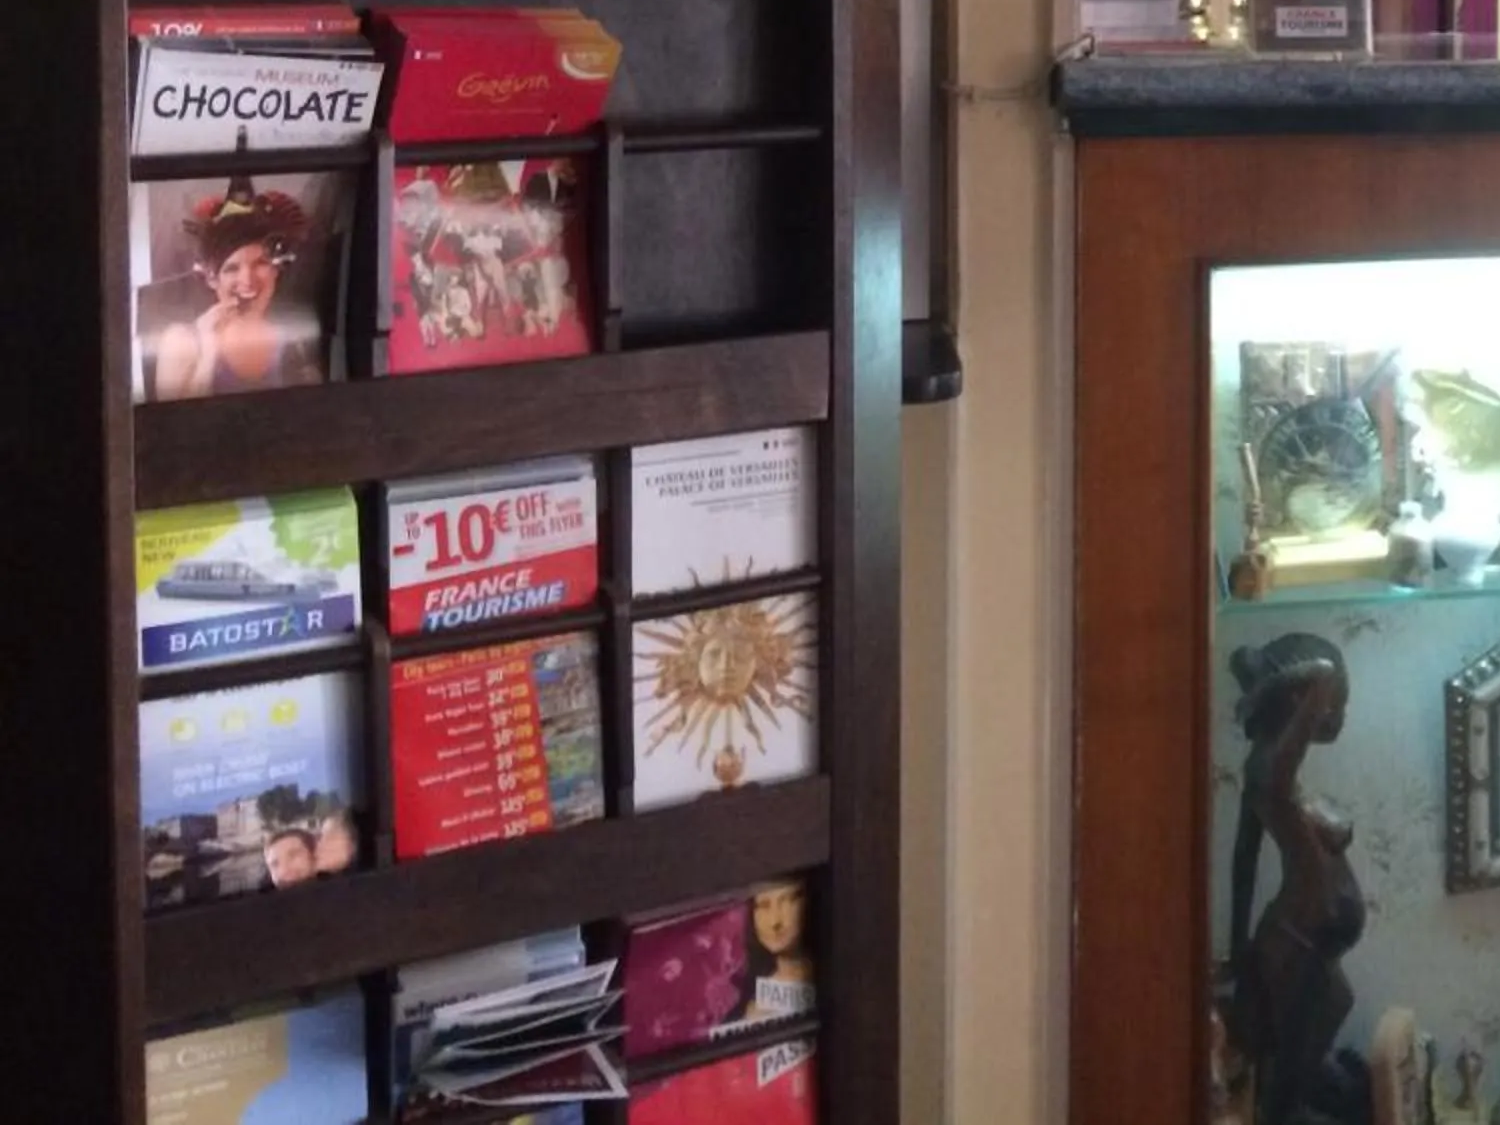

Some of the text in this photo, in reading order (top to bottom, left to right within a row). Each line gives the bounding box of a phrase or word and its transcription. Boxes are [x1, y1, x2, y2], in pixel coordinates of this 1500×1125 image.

[152, 83, 369, 124] CHOCOLATE
[515, 490, 550, 521] OFF
[424, 568, 534, 612] FRANCE
[426, 580, 565, 632] TOURISME
[761, 1041, 808, 1080] PAS
